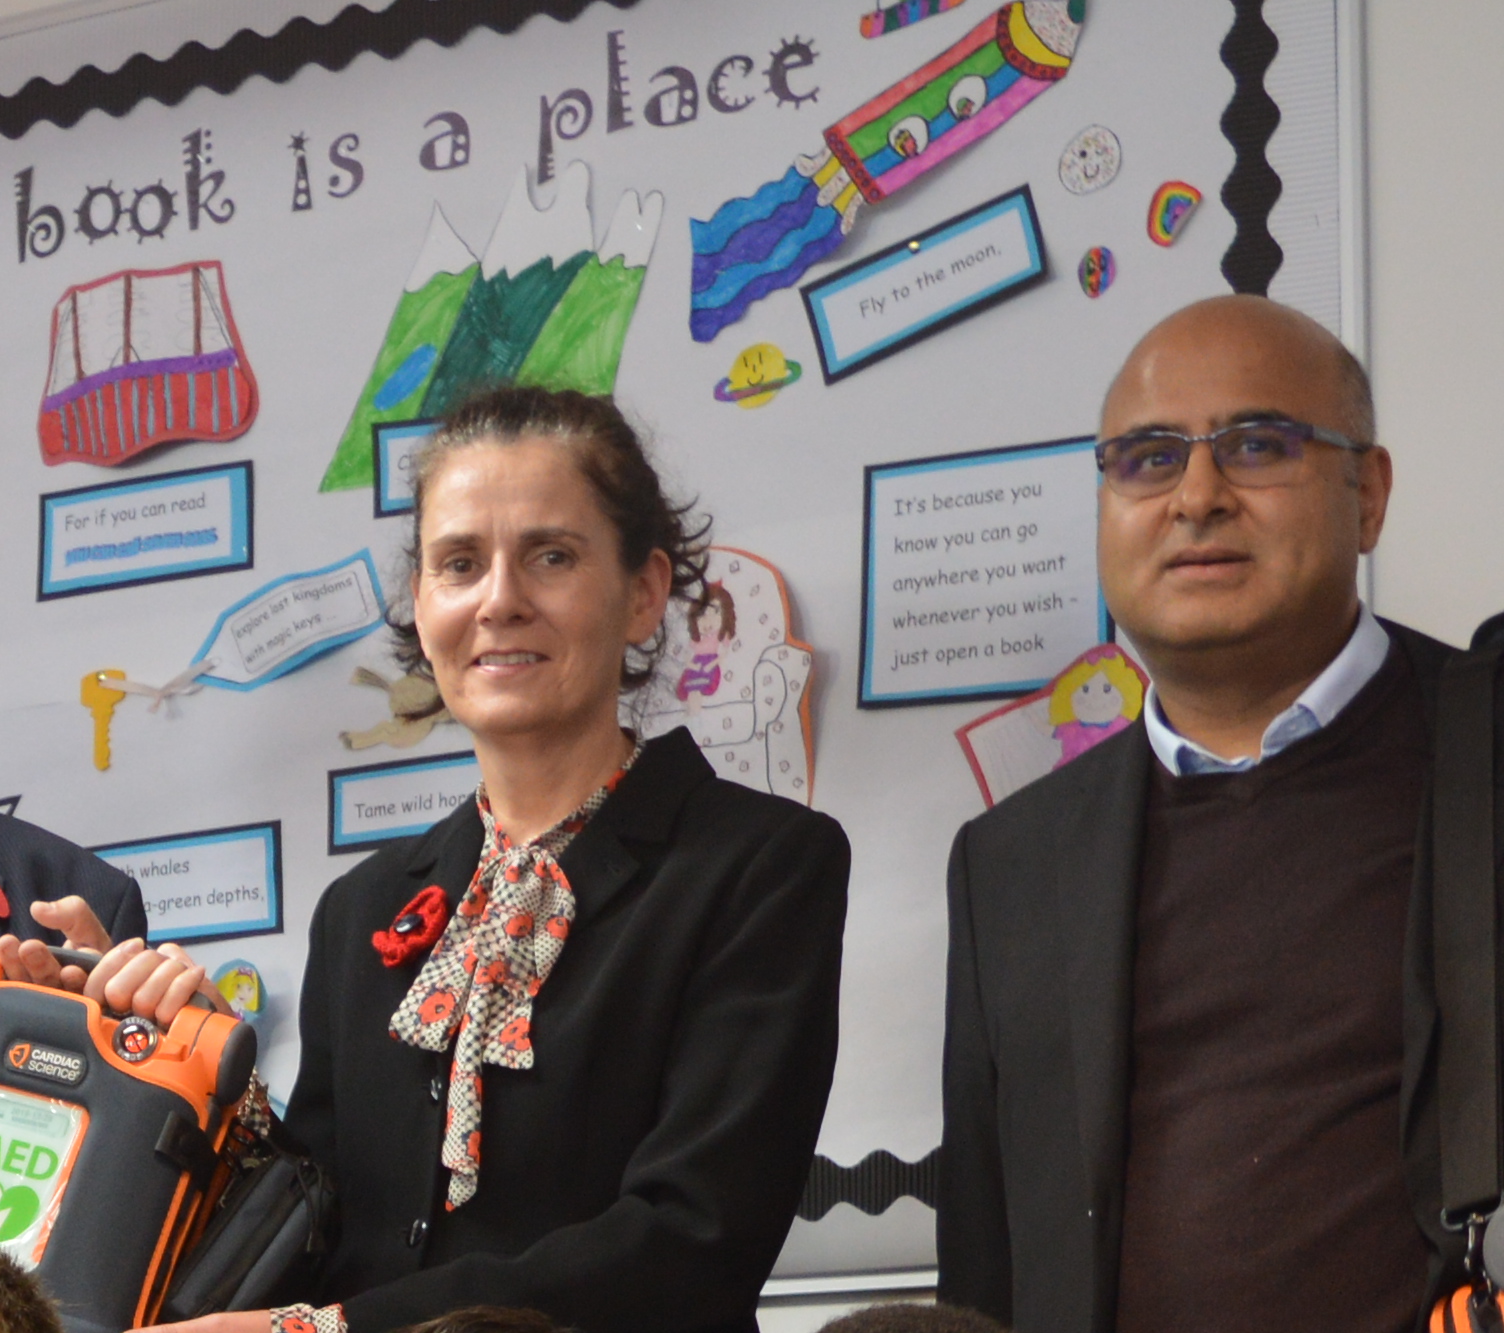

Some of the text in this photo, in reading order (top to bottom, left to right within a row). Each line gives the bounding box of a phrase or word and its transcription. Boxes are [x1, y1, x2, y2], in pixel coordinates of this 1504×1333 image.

[13, 128, 237, 264] book
[287, 131, 366, 211] is
[418, 109, 472, 172] a
[536, 29, 821, 186] place
[859, 243, 1003, 319] Fly to the moon,
[65, 491, 207, 532] For if you can read
[894, 483, 1043, 516] It's because you
[894, 522, 1039, 555] know you can go
[892, 554, 1068, 595] anywhere you want
[236, 610, 271, 640] explore
[292, 576, 354, 604] kingdoms
[892, 605, 982, 630] whenever
[986, 601, 1017, 623] you
[1022, 592, 1064, 614] wish
[245, 644, 266, 666] with
[266, 628, 292, 650] magic
[292, 612, 323, 634] keys
[890, 633, 1046, 672] just open a book
[354, 791, 469, 820] Tame wild hor
[139, 858, 191, 879] whales
[144, 885, 265, 916] a-green depths,
[31, 1049, 81, 1070] CARDIAC
